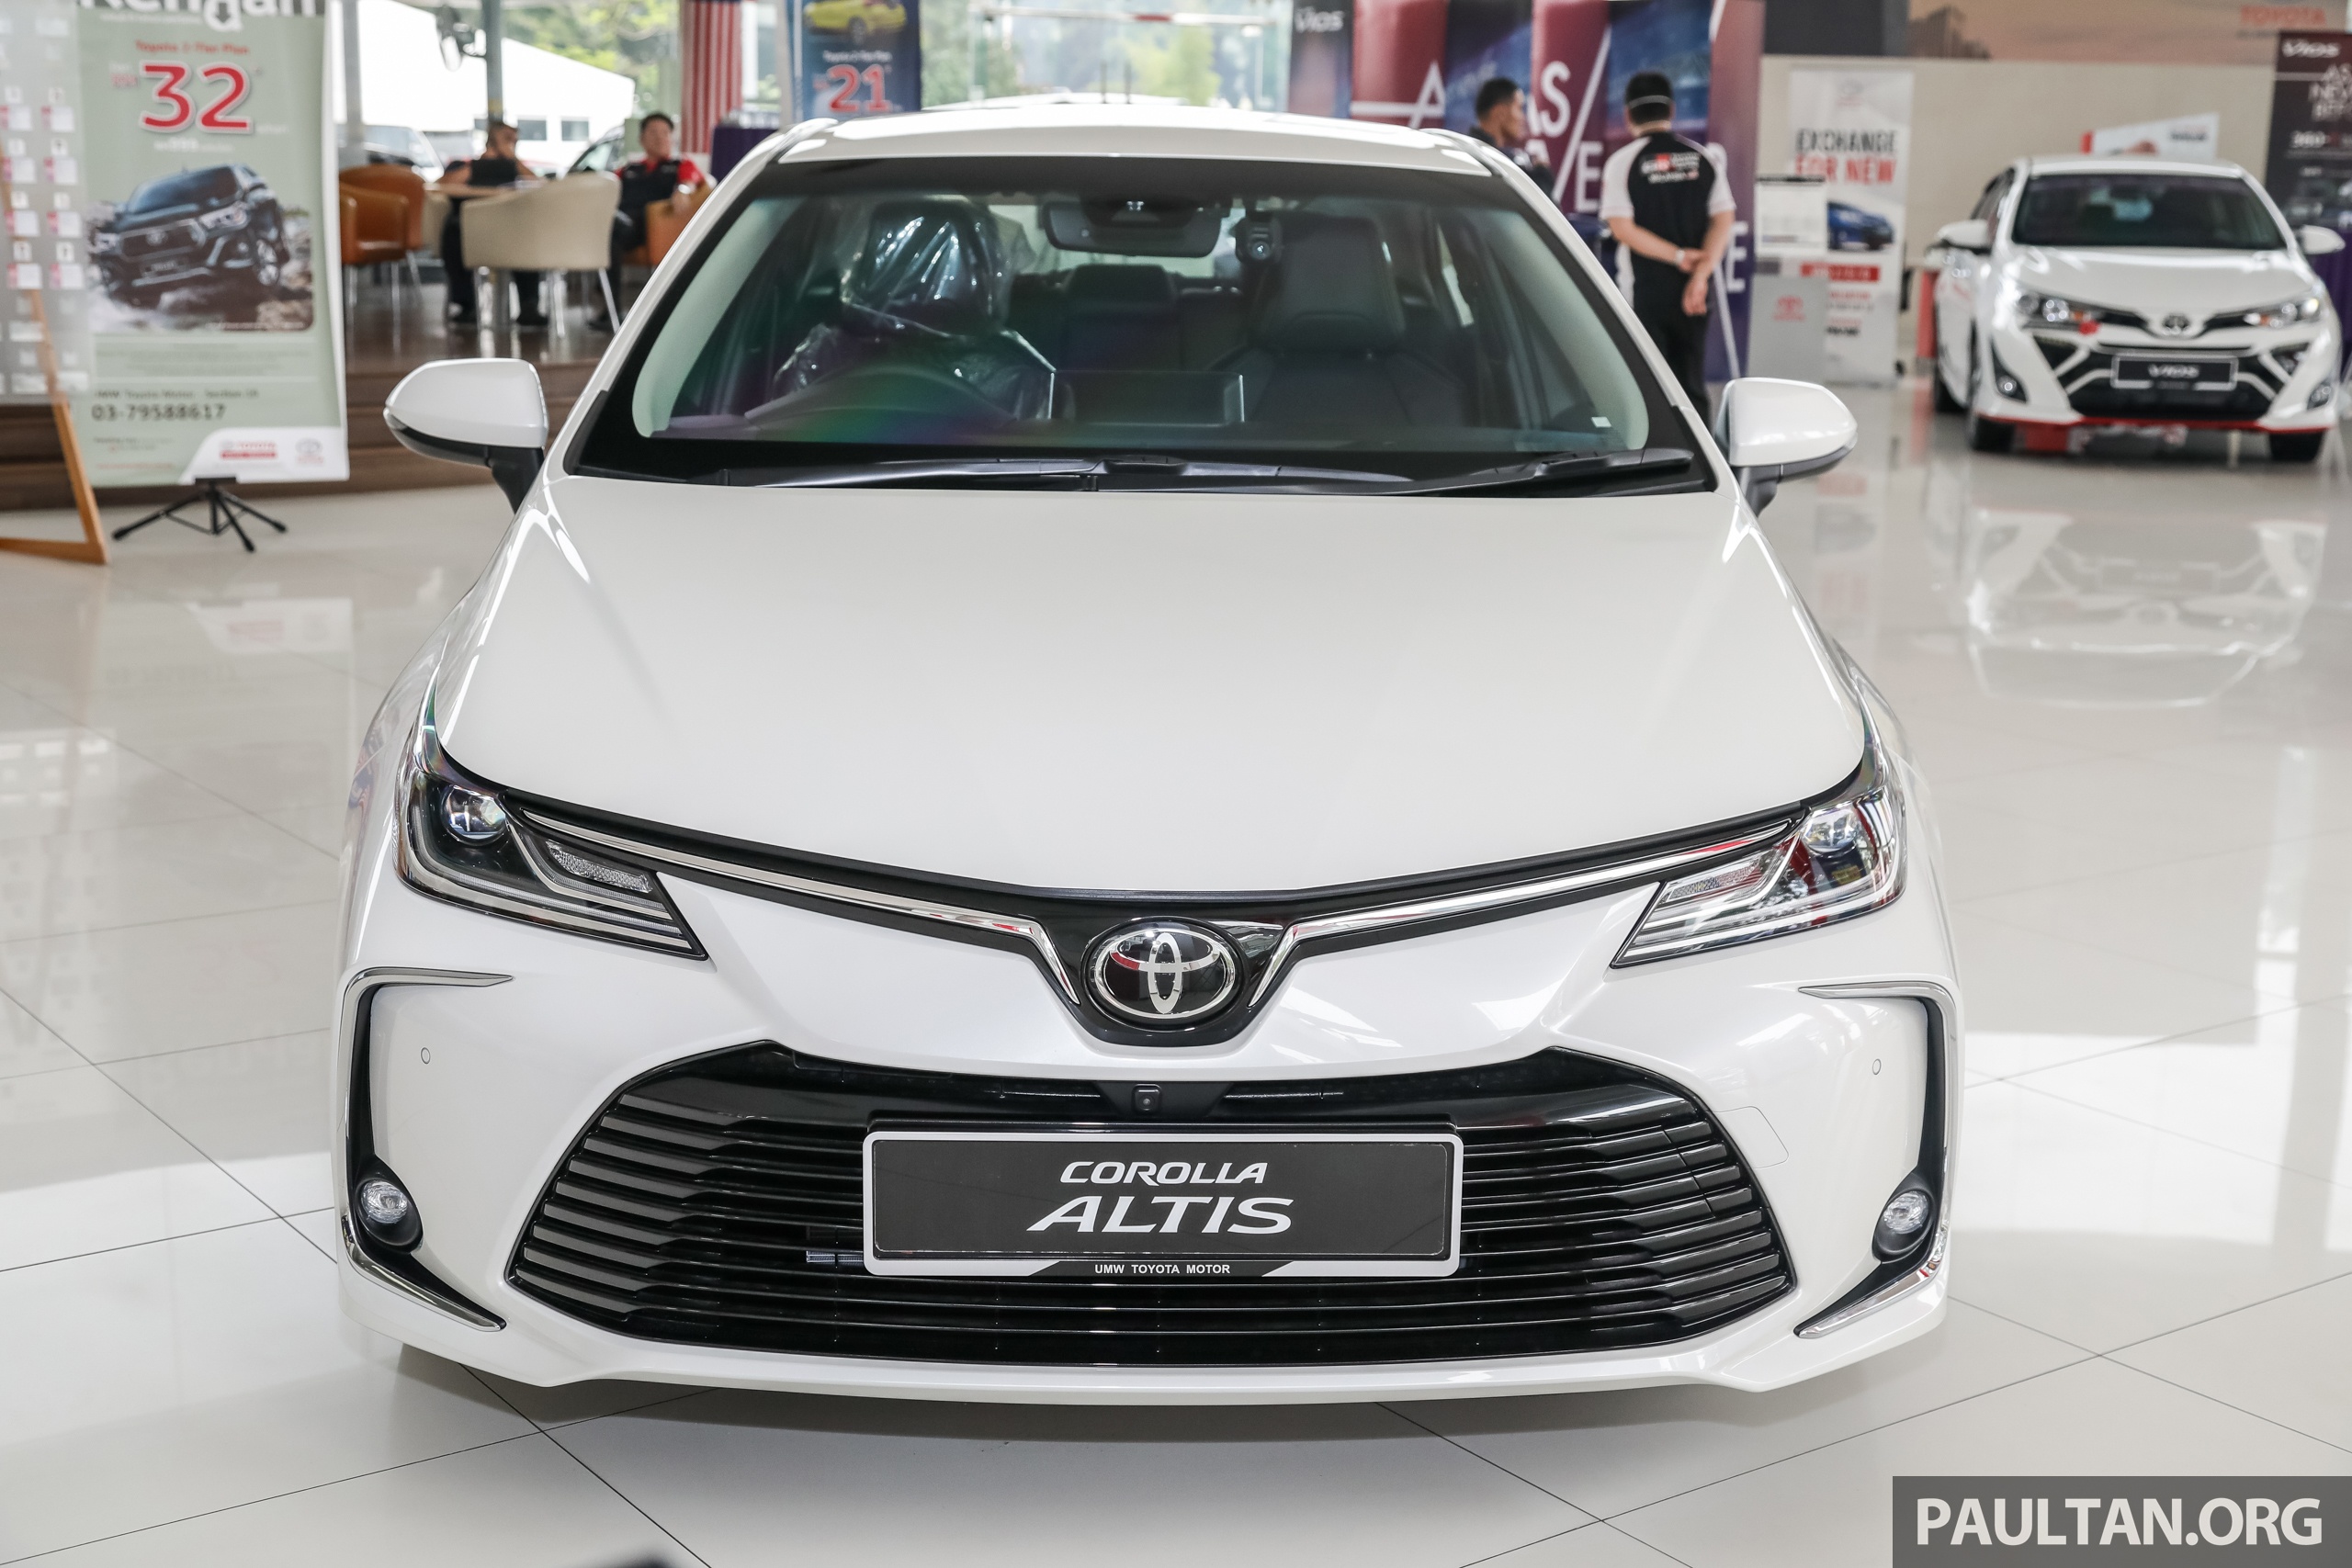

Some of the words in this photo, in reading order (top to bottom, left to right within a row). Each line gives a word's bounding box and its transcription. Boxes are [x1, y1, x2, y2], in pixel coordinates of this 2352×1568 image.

[141, 62, 251, 130] 32
[828, 64, 892, 112] 21
[1796, 128, 1897, 152] EXCHANGE
[1796, 154, 1836, 181] FOR
[1845, 156, 1897, 185] NEW
[1059, 1161, 1269, 1186] COROLLA
[1026, 1195, 1295, 1235] ALTIS
[1094, 1264, 1125, 1274] UMW
[1131, 1264, 1181, 1274] TOYOTA
[1186, 1264, 1231, 1274] MOTOR
